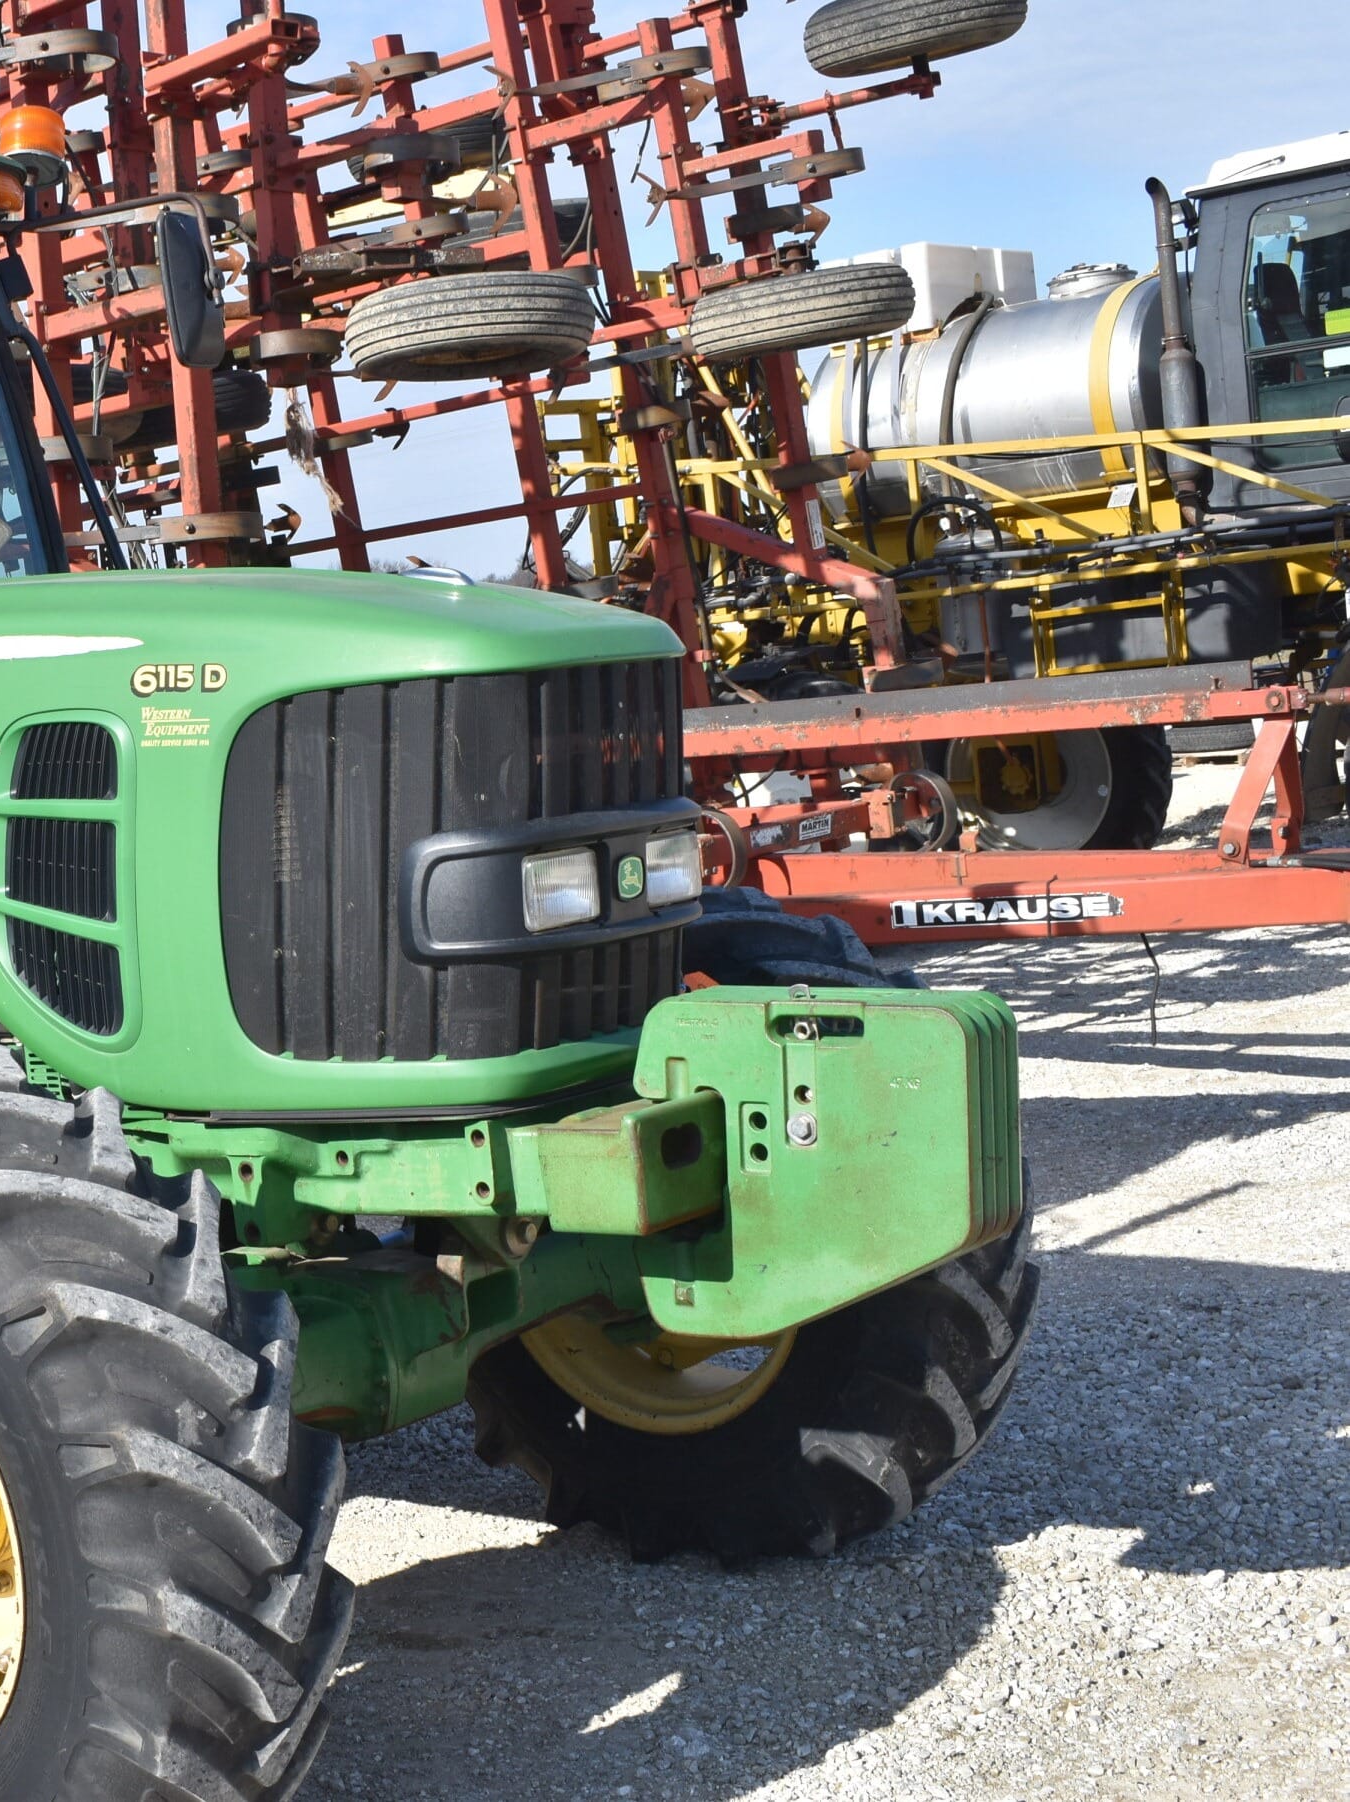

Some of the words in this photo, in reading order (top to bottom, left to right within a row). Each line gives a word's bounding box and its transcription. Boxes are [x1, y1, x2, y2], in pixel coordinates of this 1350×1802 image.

[130, 663, 195, 698] 6115
[200, 662, 228, 693] D
[140, 706, 192, 721] WESTERN
[144, 721, 210, 738] EQUIPMENT
[801, 817, 830, 832] MARTIN
[922, 895, 1110, 925] KRAUSE
